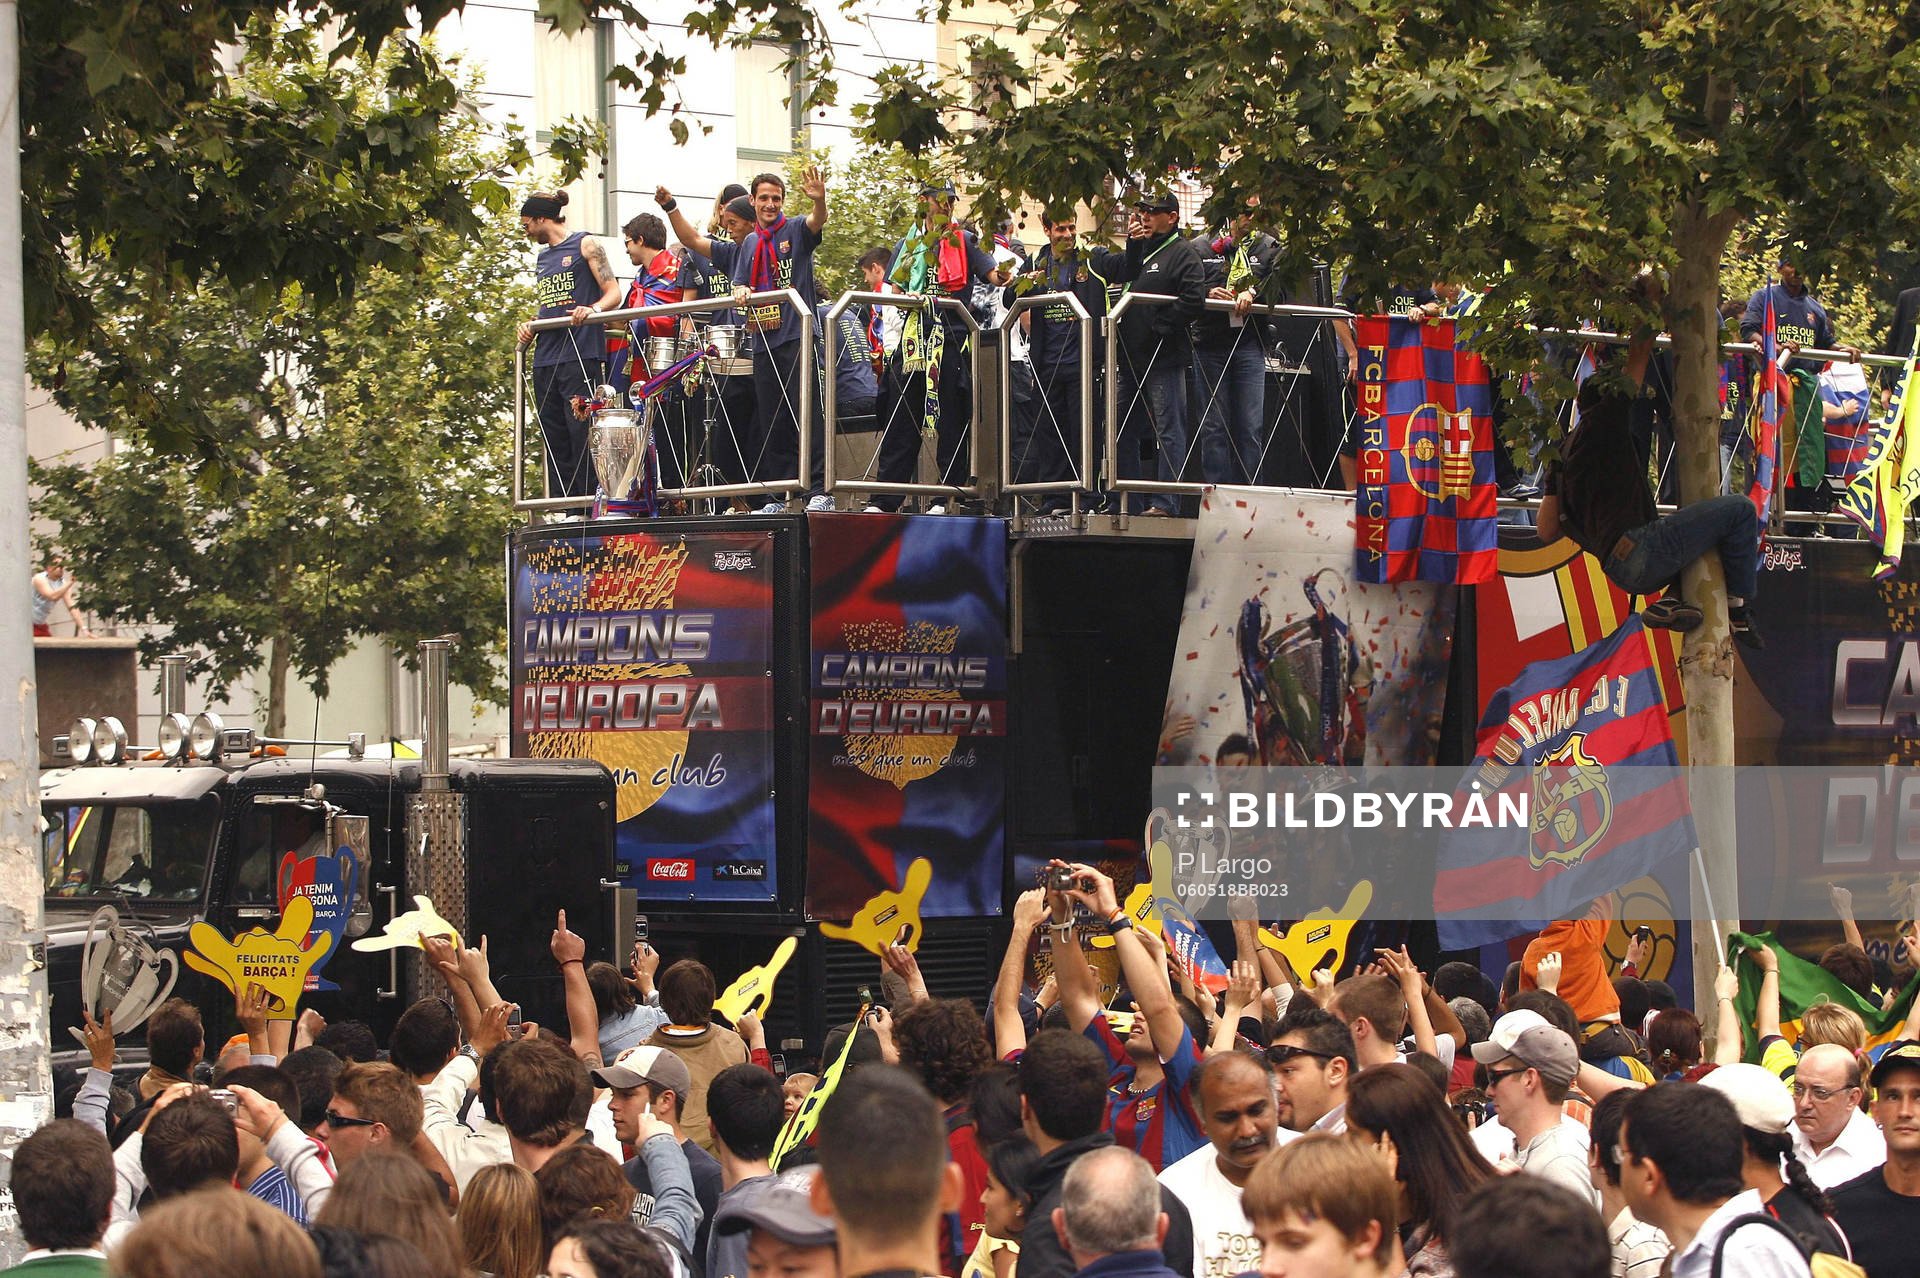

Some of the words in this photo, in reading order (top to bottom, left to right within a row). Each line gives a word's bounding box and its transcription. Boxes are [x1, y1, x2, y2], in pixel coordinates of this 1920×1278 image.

[552, 272, 574, 284] QUE
[546, 281, 575, 295] CLUB!
[1395, 295, 1415, 306] QUE
[1777, 323, 1798, 335] MÉS
[523, 614, 714, 665] CAMPIONS
[820, 654, 989, 688] CAMPIONS
[523, 681, 724, 730] D'EUROPA
[819, 699, 993, 734] D'EUROPA
[874, 752, 905, 772] que
[911, 754, 933, 766] un
[939, 748, 977, 768] club
[651, 753, 727, 788] club
[292, 887, 303, 897] JA
[304, 883, 333, 895] TENIM
[315, 911, 337, 919] BARÇA
[236, 954, 300, 964] FELICITATS
[243, 966, 288, 980] BARÇA
[291, 967, 296, 977] !
